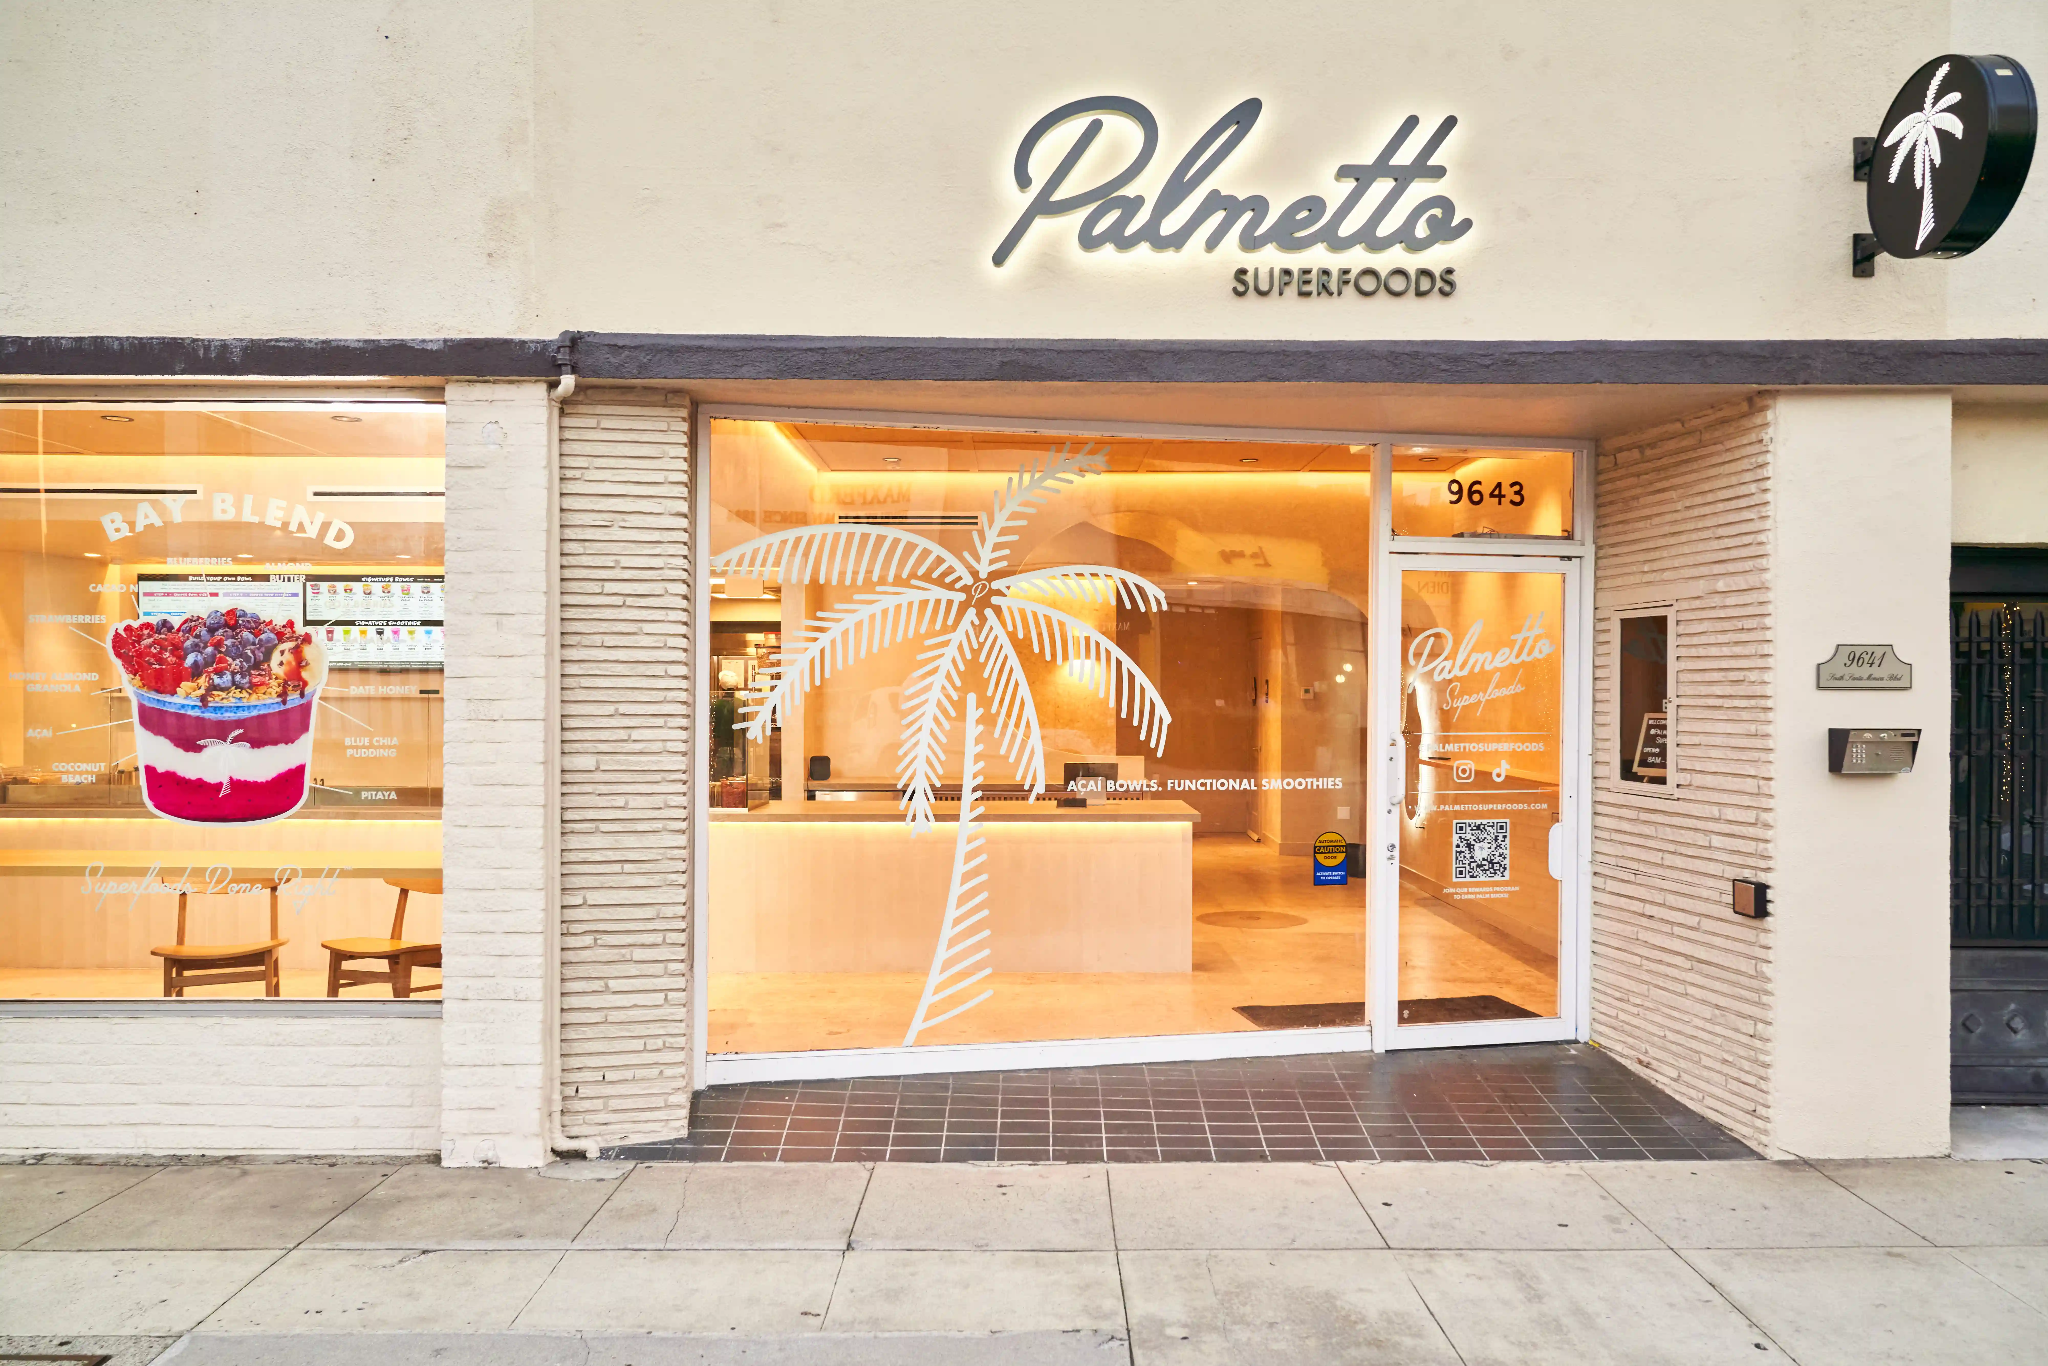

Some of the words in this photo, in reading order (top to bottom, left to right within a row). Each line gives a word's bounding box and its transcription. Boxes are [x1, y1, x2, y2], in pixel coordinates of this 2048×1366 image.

[992, 95, 1473, 267] Palmetto
[1232, 266, 1457, 298] SUPERFOODS
[1447, 478, 1525, 507] 9643
[100, 494, 187, 542] BAY
[212, 492, 355, 550] BLEND
[166, 556, 233, 566] BLUEBERRIES
[264, 562, 312, 572] ALMOND
[269, 574, 306, 583] BUTTER
[89, 583, 127, 592] CACAO
[28, 614, 106, 624] STRAWBERRIES
[1408, 611, 1555, 694] Palmetto
[1844, 650, 1887, 668] 9641
[9, 672, 47, 681] HONEY
[50, 672, 99, 681] ALMOND
[27, 683, 81, 693] GRANOLA
[350, 685, 375, 695] DATE
[378, 685, 417, 695] HONEY
[1443, 668, 1525, 722] Superfoods
[27, 727, 52, 739] AÇAÍ
[344, 737, 370, 746] BLUE
[373, 737, 399, 746] CHIA
[346, 748, 397, 757] PUDDING
[52, 762, 106, 771] COCONUT
[61, 774, 96, 783] BEACH
[1067, 776, 1103, 796] AÇAÍ
[1106, 779, 1163, 792] BOWLS.
[1167, 778, 1257, 791] FUNCTIONAL
[1261, 777, 1343, 790] SMOOTHIES
[361, 790, 398, 800] PITAYA
[1414, 803, 1548, 812] WW.PALMETTOSUPERFOODS.COM
[81, 861, 196, 912] Superfoods
[205, 863, 264, 895] Done
